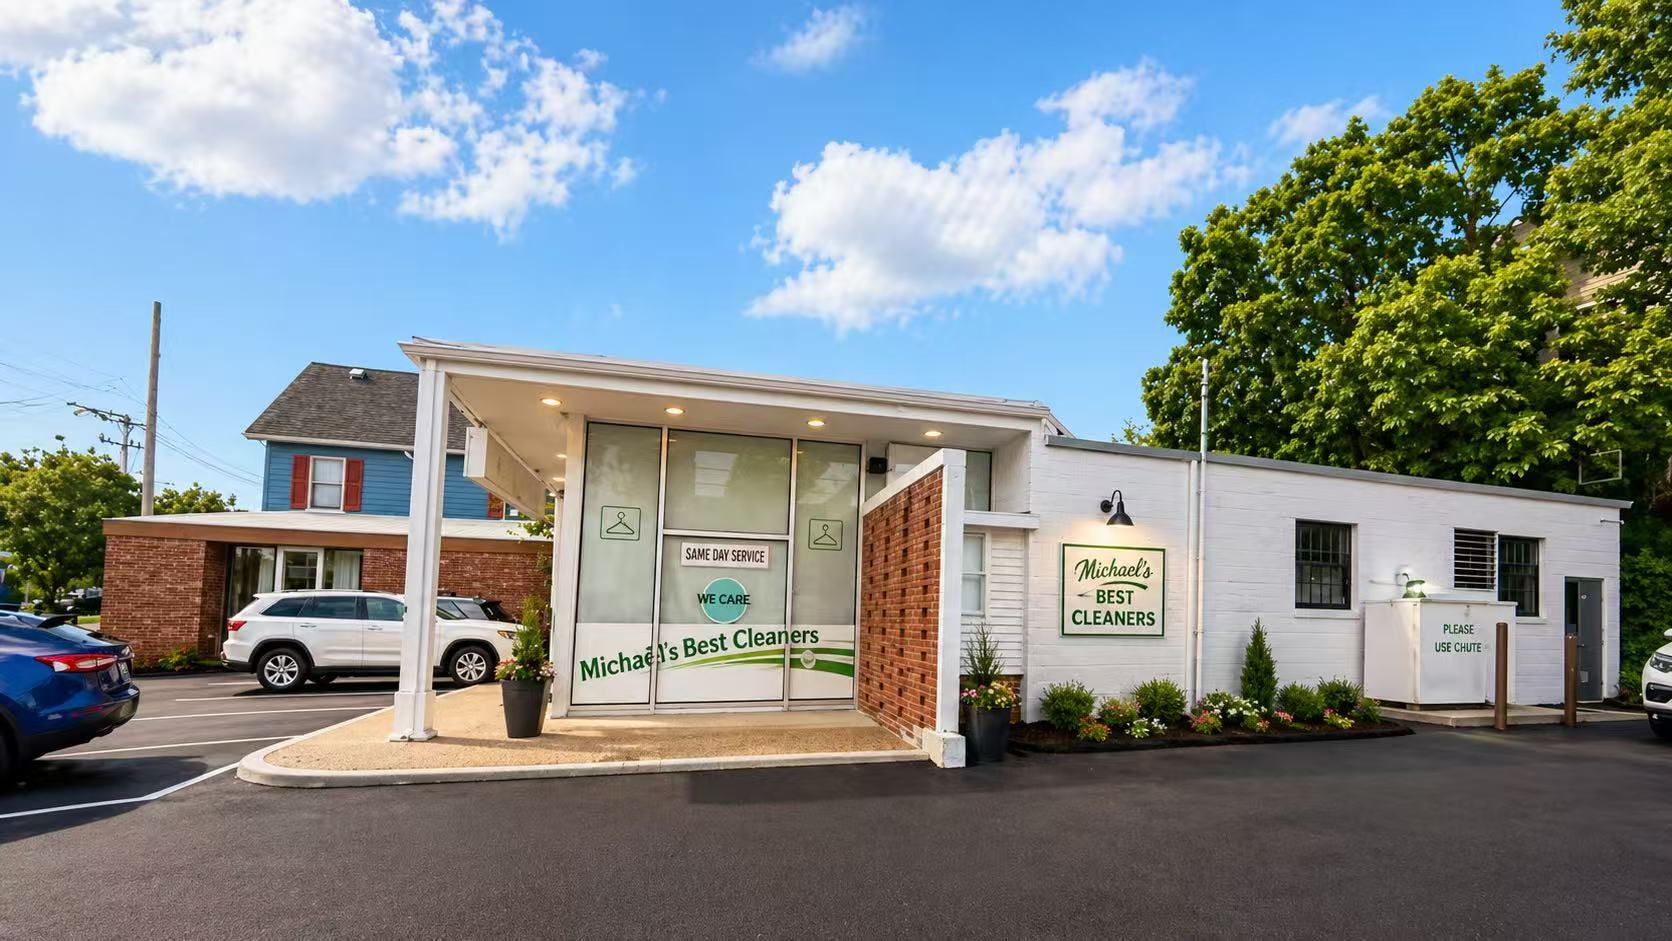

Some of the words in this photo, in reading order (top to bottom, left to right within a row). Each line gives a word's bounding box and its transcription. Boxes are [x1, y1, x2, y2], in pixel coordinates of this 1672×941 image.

[686, 547, 711, 561] SAME
[712, 548, 730, 562] DAY
[731, 549, 765, 563] SERVICE
[1074, 557, 1153, 582] Michael's
[697, 593, 716, 605] WE
[718, 594, 752, 605] CARE
[1096, 589, 1134, 604] BEST
[1071, 609, 1156, 626] CLEANERS
[1443, 623, 1474, 635] PLEASE
[683, 633, 728, 658] Best
[733, 628, 820, 649] Cleaners
[1435, 641, 1452, 653] USE
[1454, 642, 1482, 653] CHUTE
